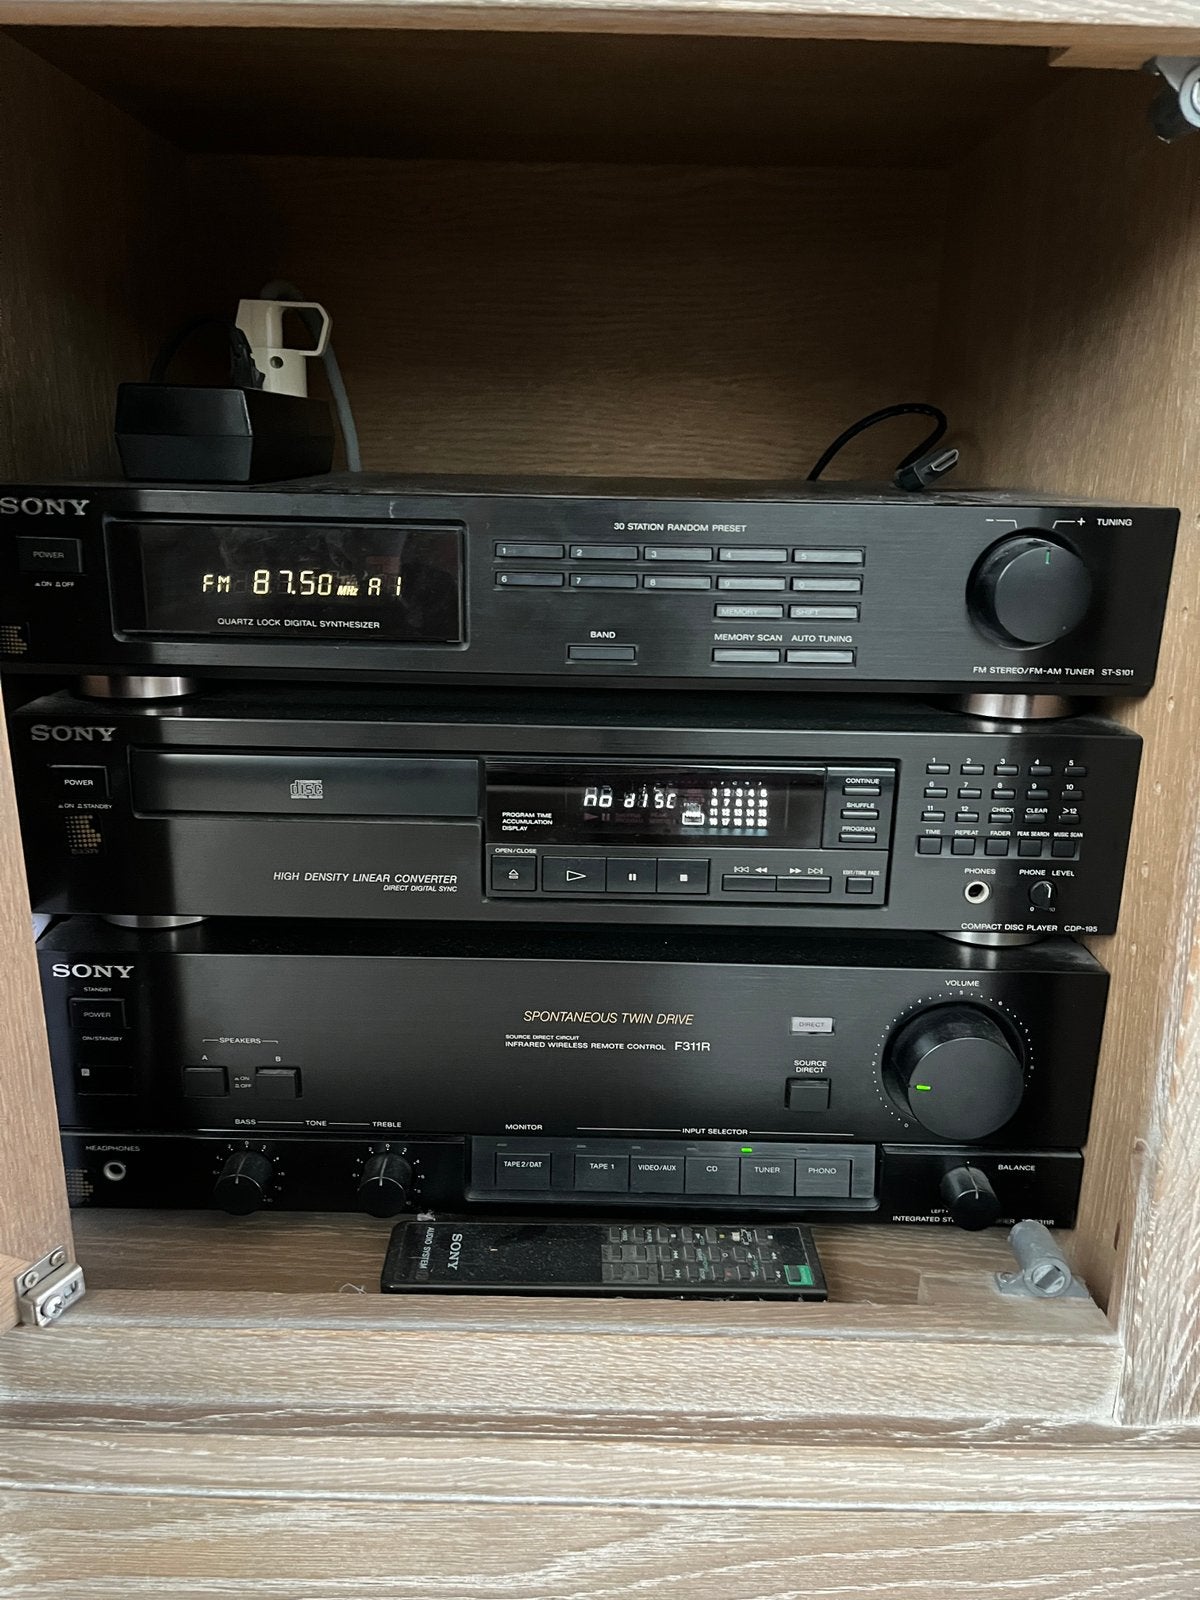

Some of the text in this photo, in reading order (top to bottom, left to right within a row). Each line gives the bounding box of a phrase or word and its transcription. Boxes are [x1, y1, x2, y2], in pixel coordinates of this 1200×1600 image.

[0, 498, 91, 516] SONY
[614, 522, 747, 533] 30 STATION RANDOM PRESET
[1096, 518, 1132, 527] TUNING
[32, 550, 64, 559] POWER
[202, 574, 230, 593] FM
[253, 570, 333, 596] 87.50
[336, 585, 359, 596] MHz
[368, 578, 381, 596] A
[721, 608, 758, 616] MEMORY
[796, 609, 819, 617] SHIFT
[217, 618, 381, 629] QUARTZ LOCK DIGITAL SYNTHESIZER
[714, 633, 783, 642] MEMORY SCAN
[791, 634, 853, 643] AUTO TUNING
[973, 666, 1134, 676] FM STEREO/FM-AM TUNER ST-S101
[30, 724, 117, 742] SONY
[712, 788, 718, 797] 1
[724, 788, 731, 796] 2
[748, 788, 755, 798] 4
[724, 798, 768, 808] 7 10
[710, 808, 718, 816] 11
[722, 808, 730, 816] 12
[734, 808, 742, 816] 13
[746, 808, 754, 816] 14
[722, 818, 730, 826] 17
[274, 872, 458, 884] HIGH DENSITY LINEAR CONVERTER
[961, 922, 1002, 930] COMPACT
[1026, 924, 1058, 932] PLAYER
[52, 964, 134, 979] SONY
[523, 1010, 694, 1026] SPONTANEOUS TWIN DRIVE
[505, 1040, 711, 1052] INFRARED WIRELESS REMOTE CONTROL F311R
[638, 1164, 676, 1172] VIDEO/AUX
[706, 1165, 718, 1173] CD
[424, 1226, 435, 1245] AUDIO
[447, 1233, 463, 1270] SONY
[418, 1246, 431, 1269] SYSTEM
